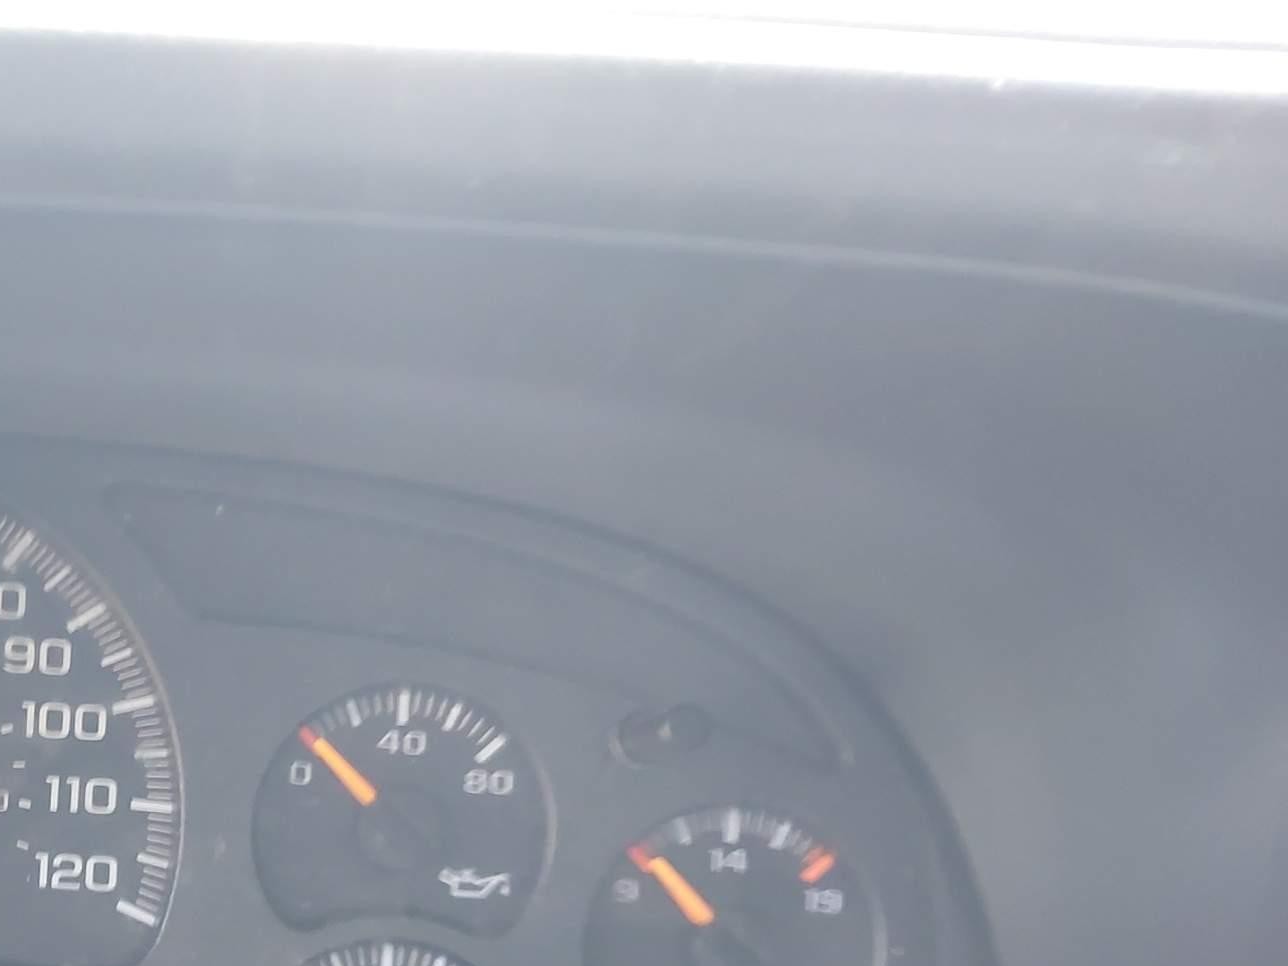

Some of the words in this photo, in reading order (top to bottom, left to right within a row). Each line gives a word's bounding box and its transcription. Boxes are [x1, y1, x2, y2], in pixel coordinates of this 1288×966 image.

[3, 636, 72, 676] 90
[21, 701, 107, 742] 100
[376, 729, 427, 756] 40
[289, 760, 312, 786] 0
[463, 769, 514, 795] 80
[45, 775, 117, 815] 110
[35, 852, 118, 892] 120
[708, 847, 747, 874] 14
